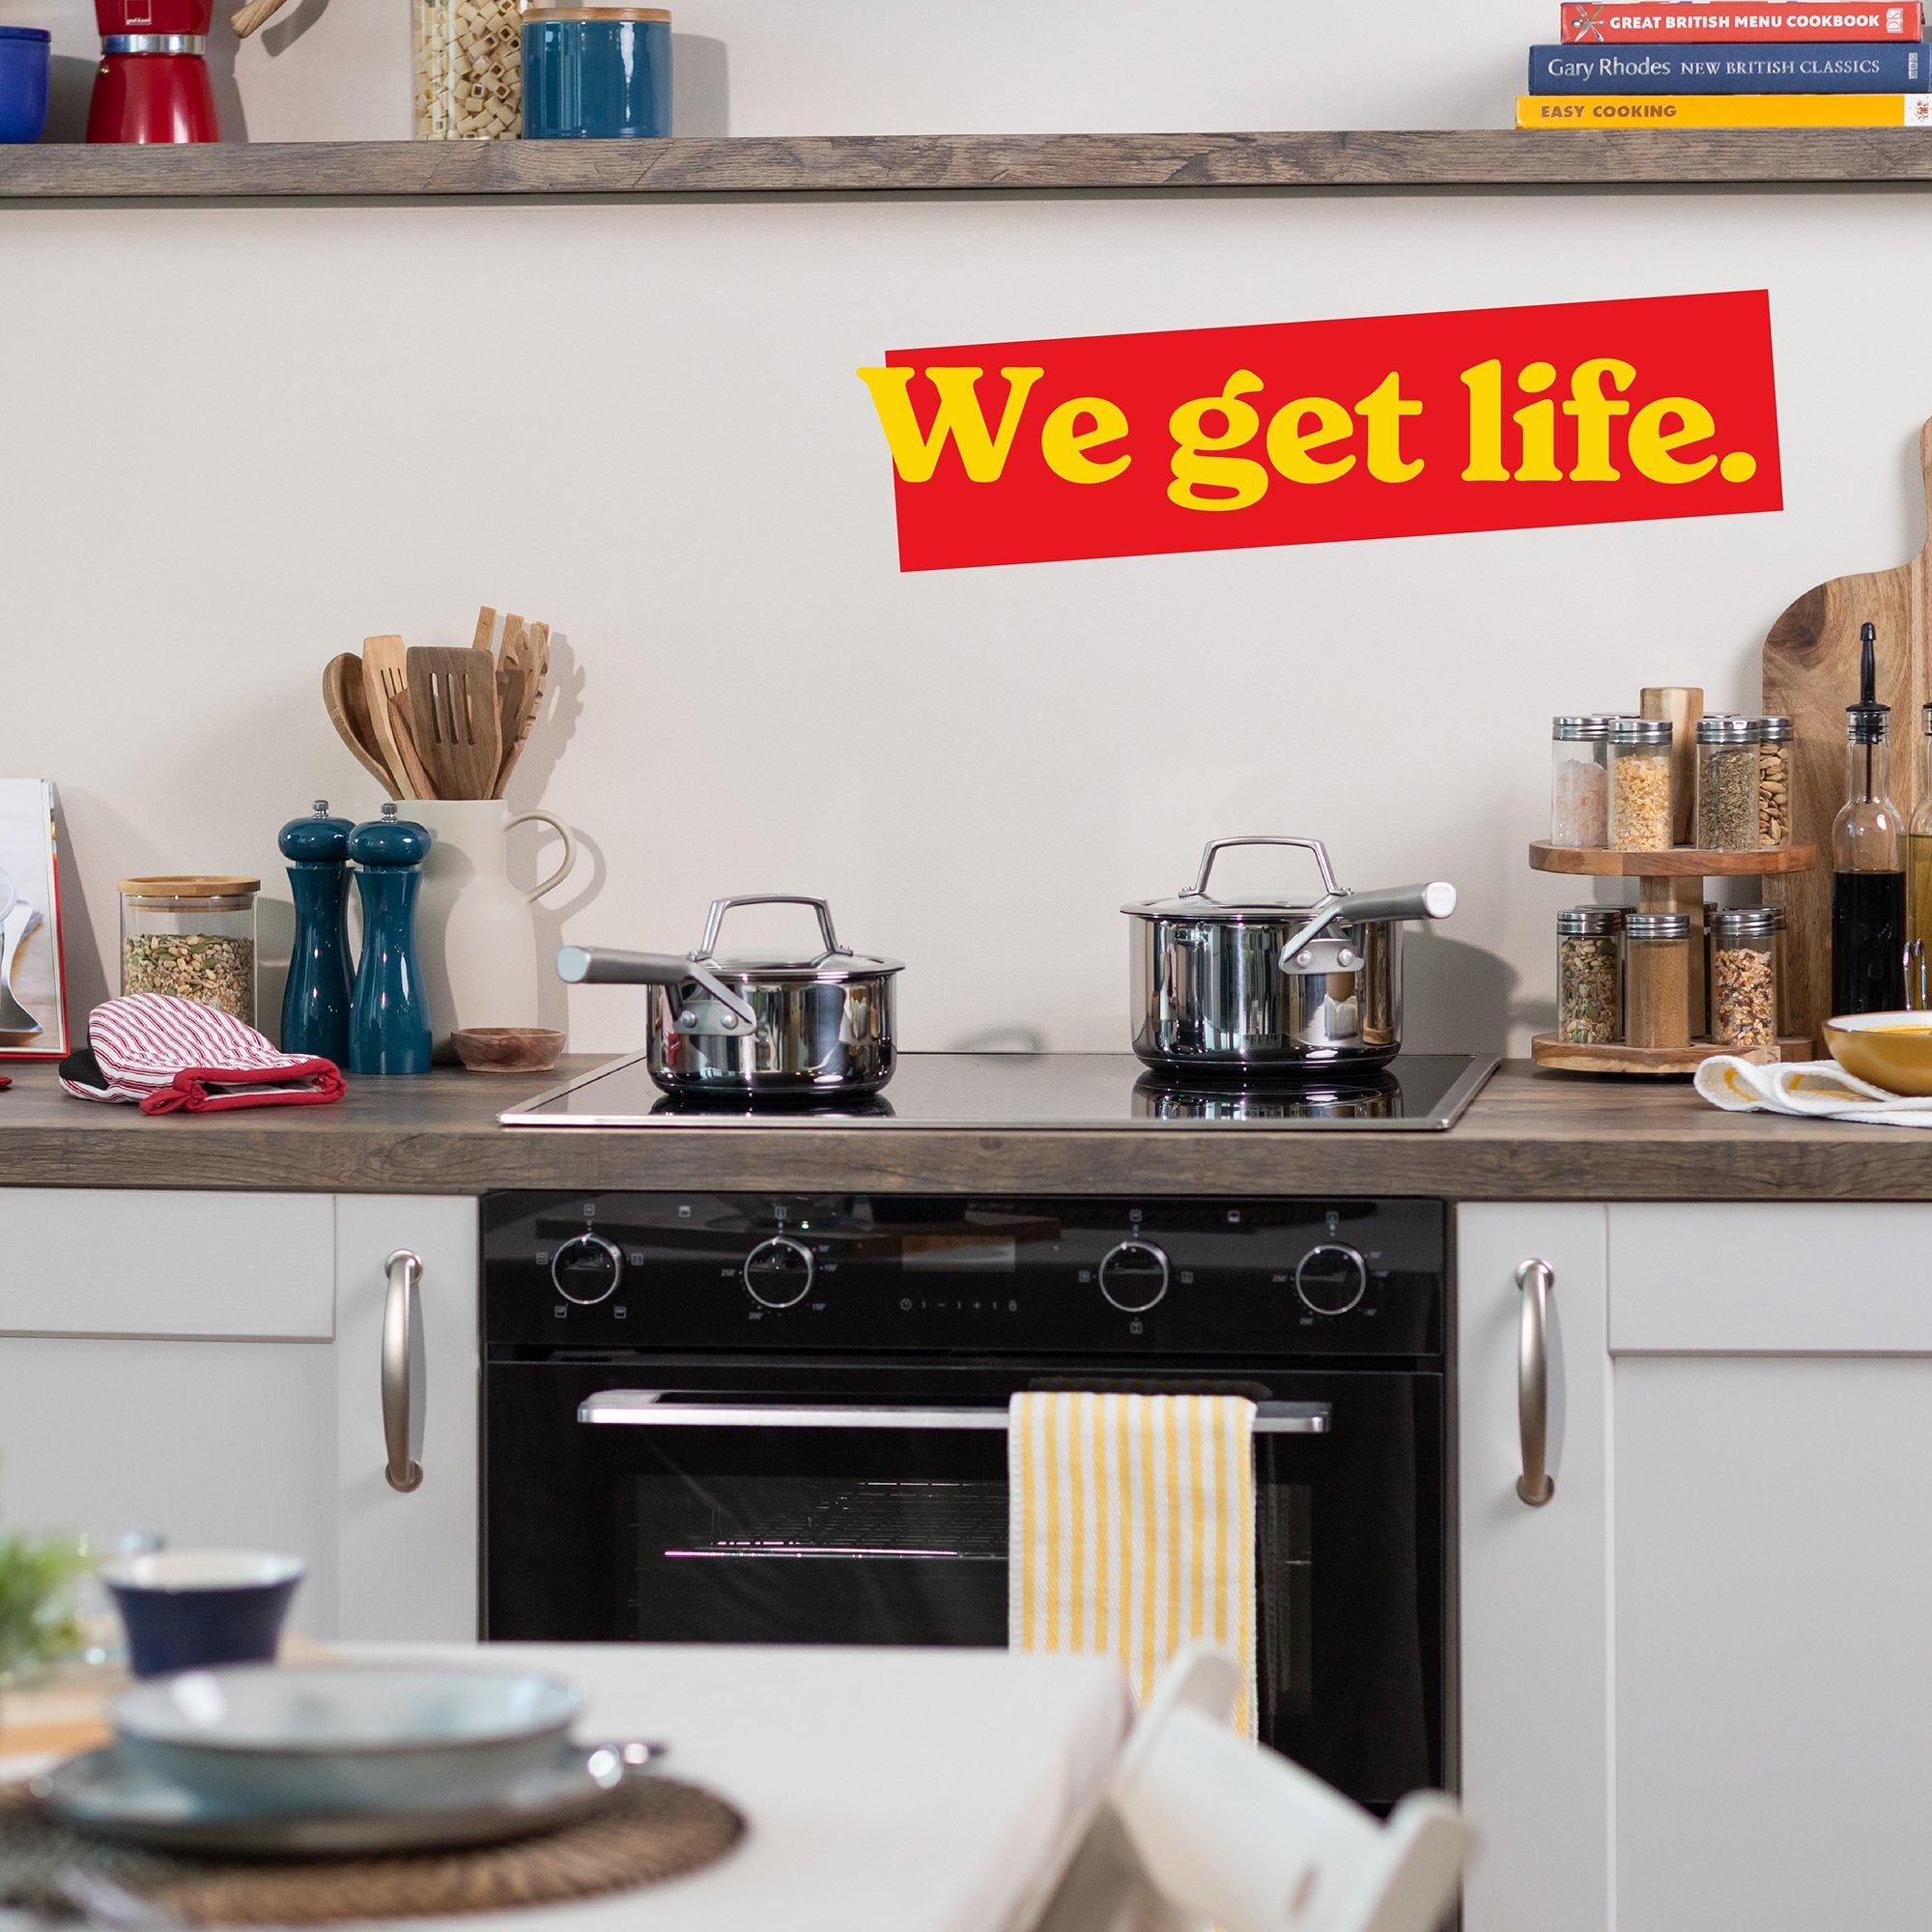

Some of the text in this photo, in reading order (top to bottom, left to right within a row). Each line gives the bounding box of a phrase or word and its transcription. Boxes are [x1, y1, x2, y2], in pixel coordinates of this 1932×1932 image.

[1610, 14, 1880, 30] GREAT BRITISH MENU COOKBOOK
[1548, 56, 1881, 82] Gary Rhodes NEW BRITISH CLASSICS
[1542, 104, 1677, 118] EASY COOKING
